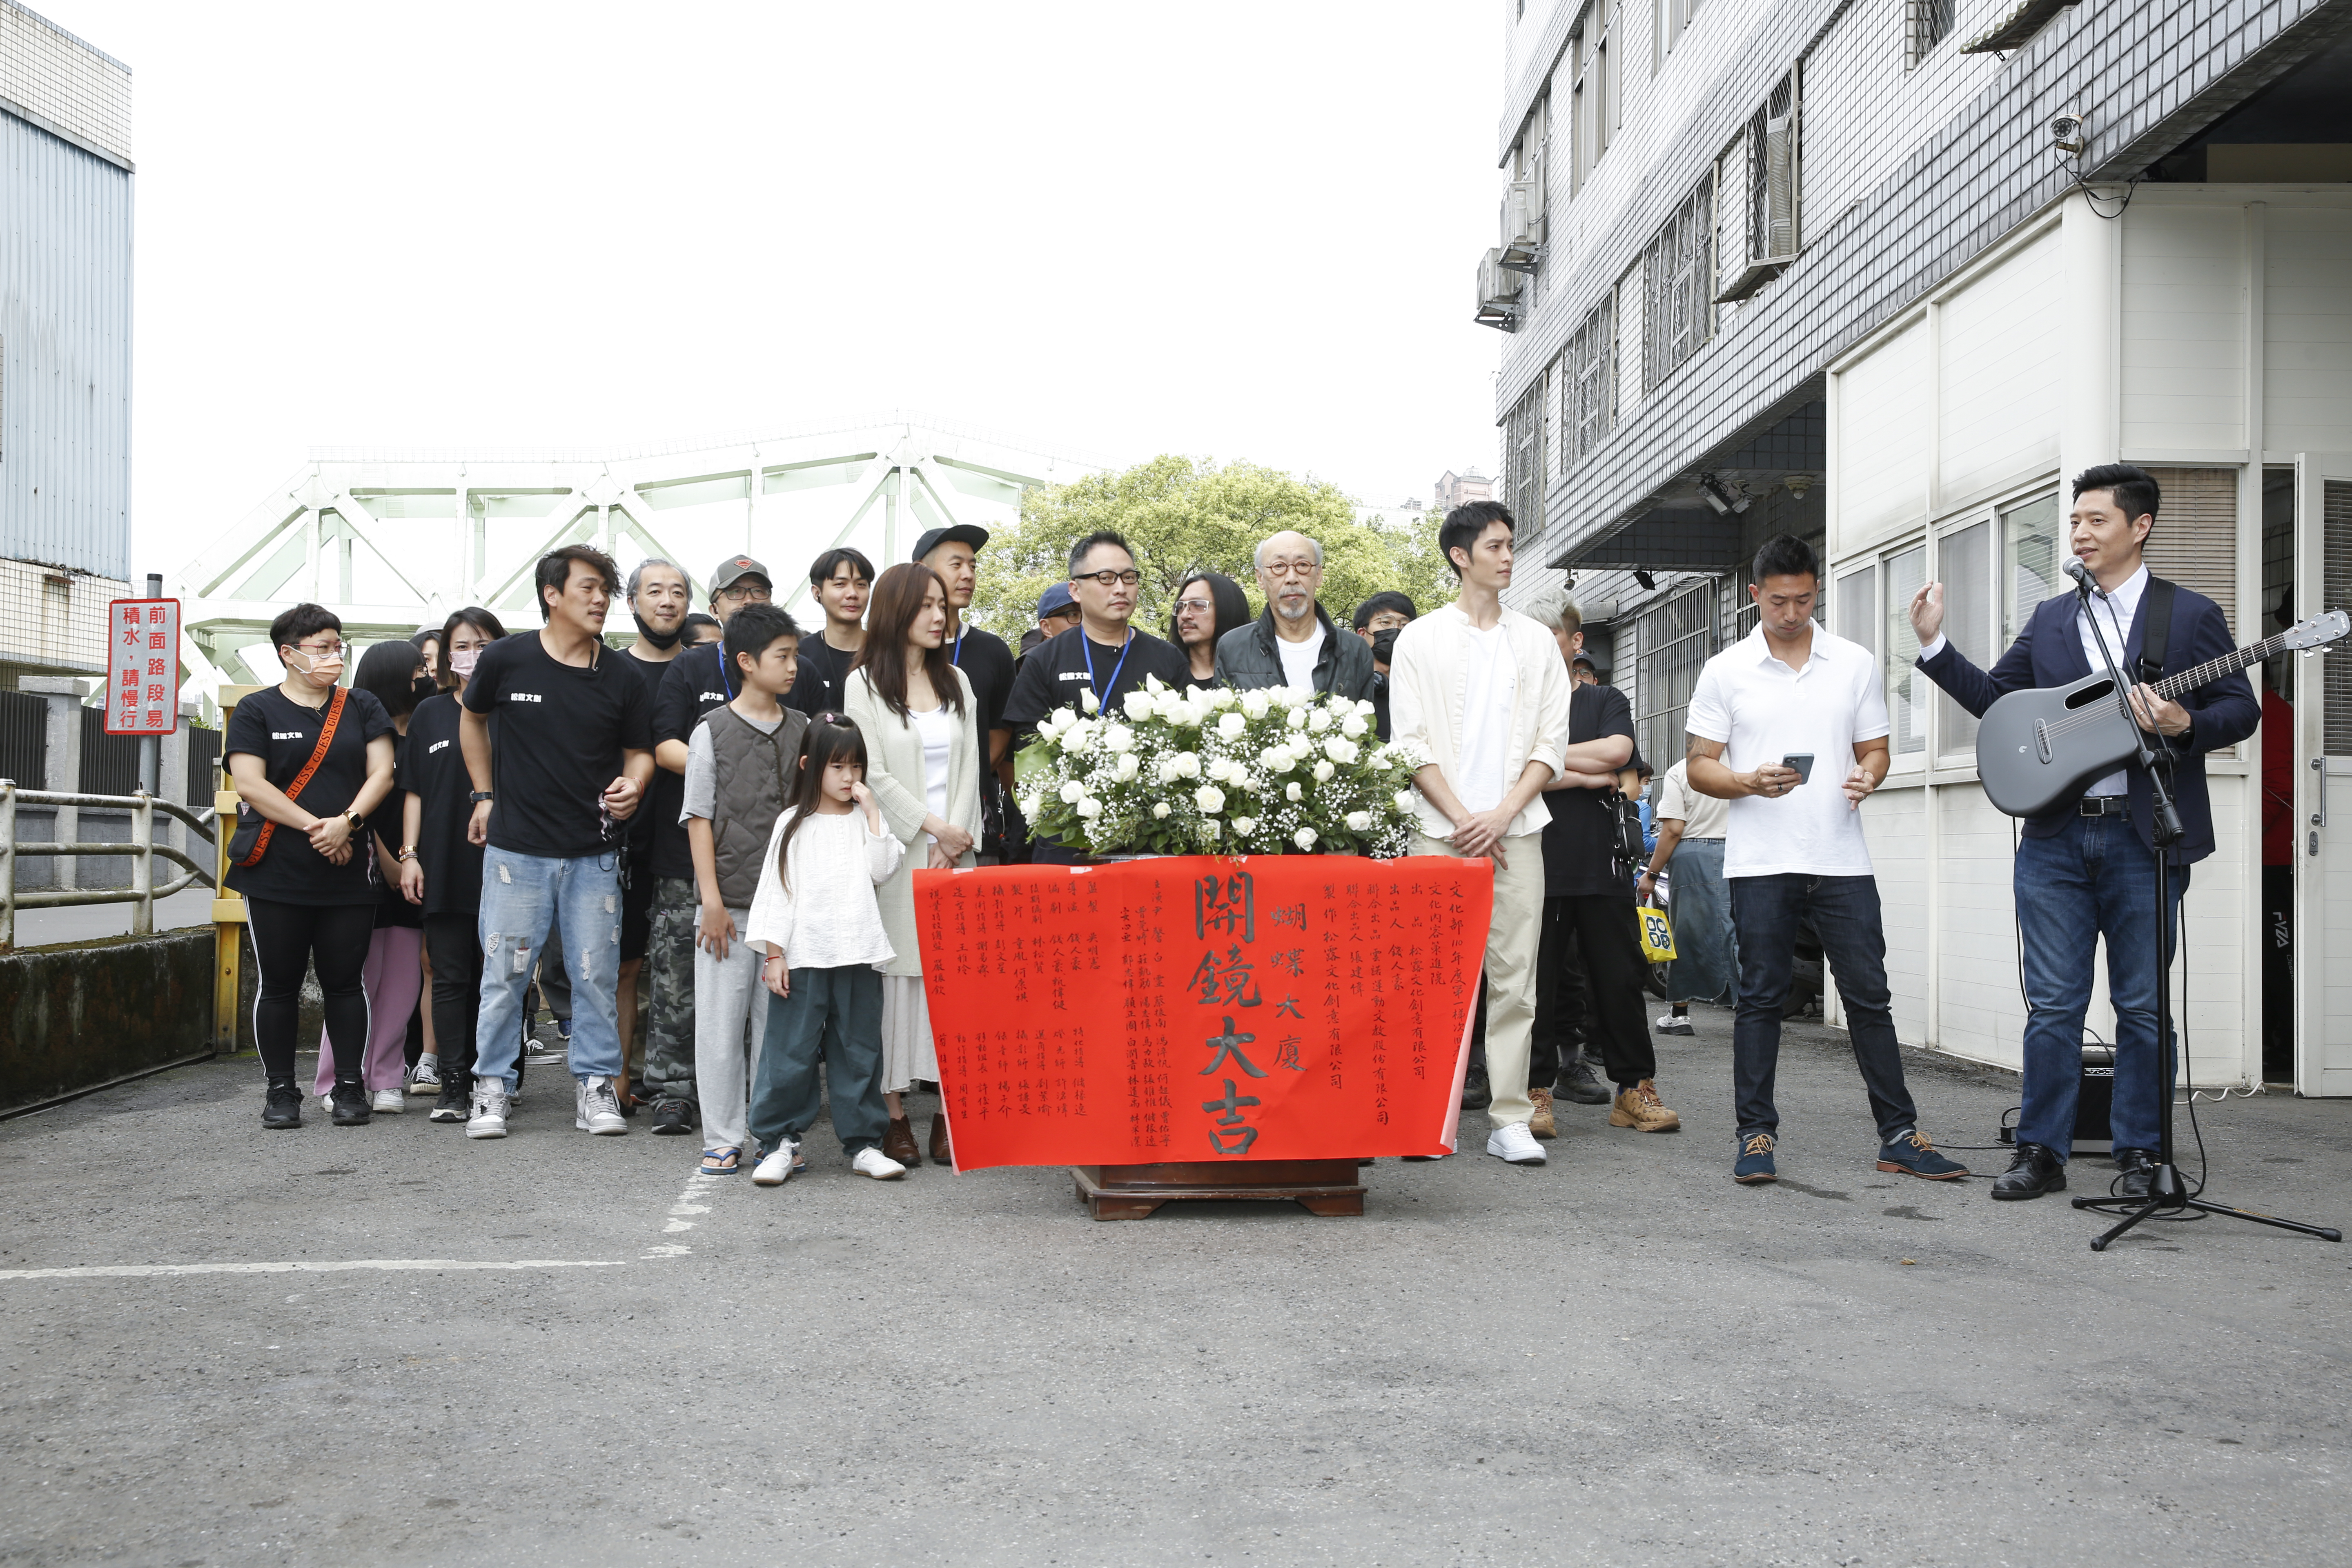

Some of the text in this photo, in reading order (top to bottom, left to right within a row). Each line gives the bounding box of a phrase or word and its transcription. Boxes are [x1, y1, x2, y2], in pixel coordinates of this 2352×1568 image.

[146, 606, 166, 728] 前面路段易
[327, 699, 343, 726] GUESS
[312, 729, 333, 762] GUESS
[286, 765, 314, 800] GUESS
[248, 828, 272, 864] GUESS
[1012, 884, 1023, 918] 製片
[1323, 884, 1337, 922] 製作
[1368, 884, 1382, 940] 聯合出品
[1390, 884, 1404, 929] 出品人
[1412, 883, 1422, 927] 出品
[1429, 882, 1446, 984] 文化內容策進院
[1270, 903, 1308, 1071] 蝴蝶大廈
[1187, 871, 1269, 1154] 開鏡大吉
